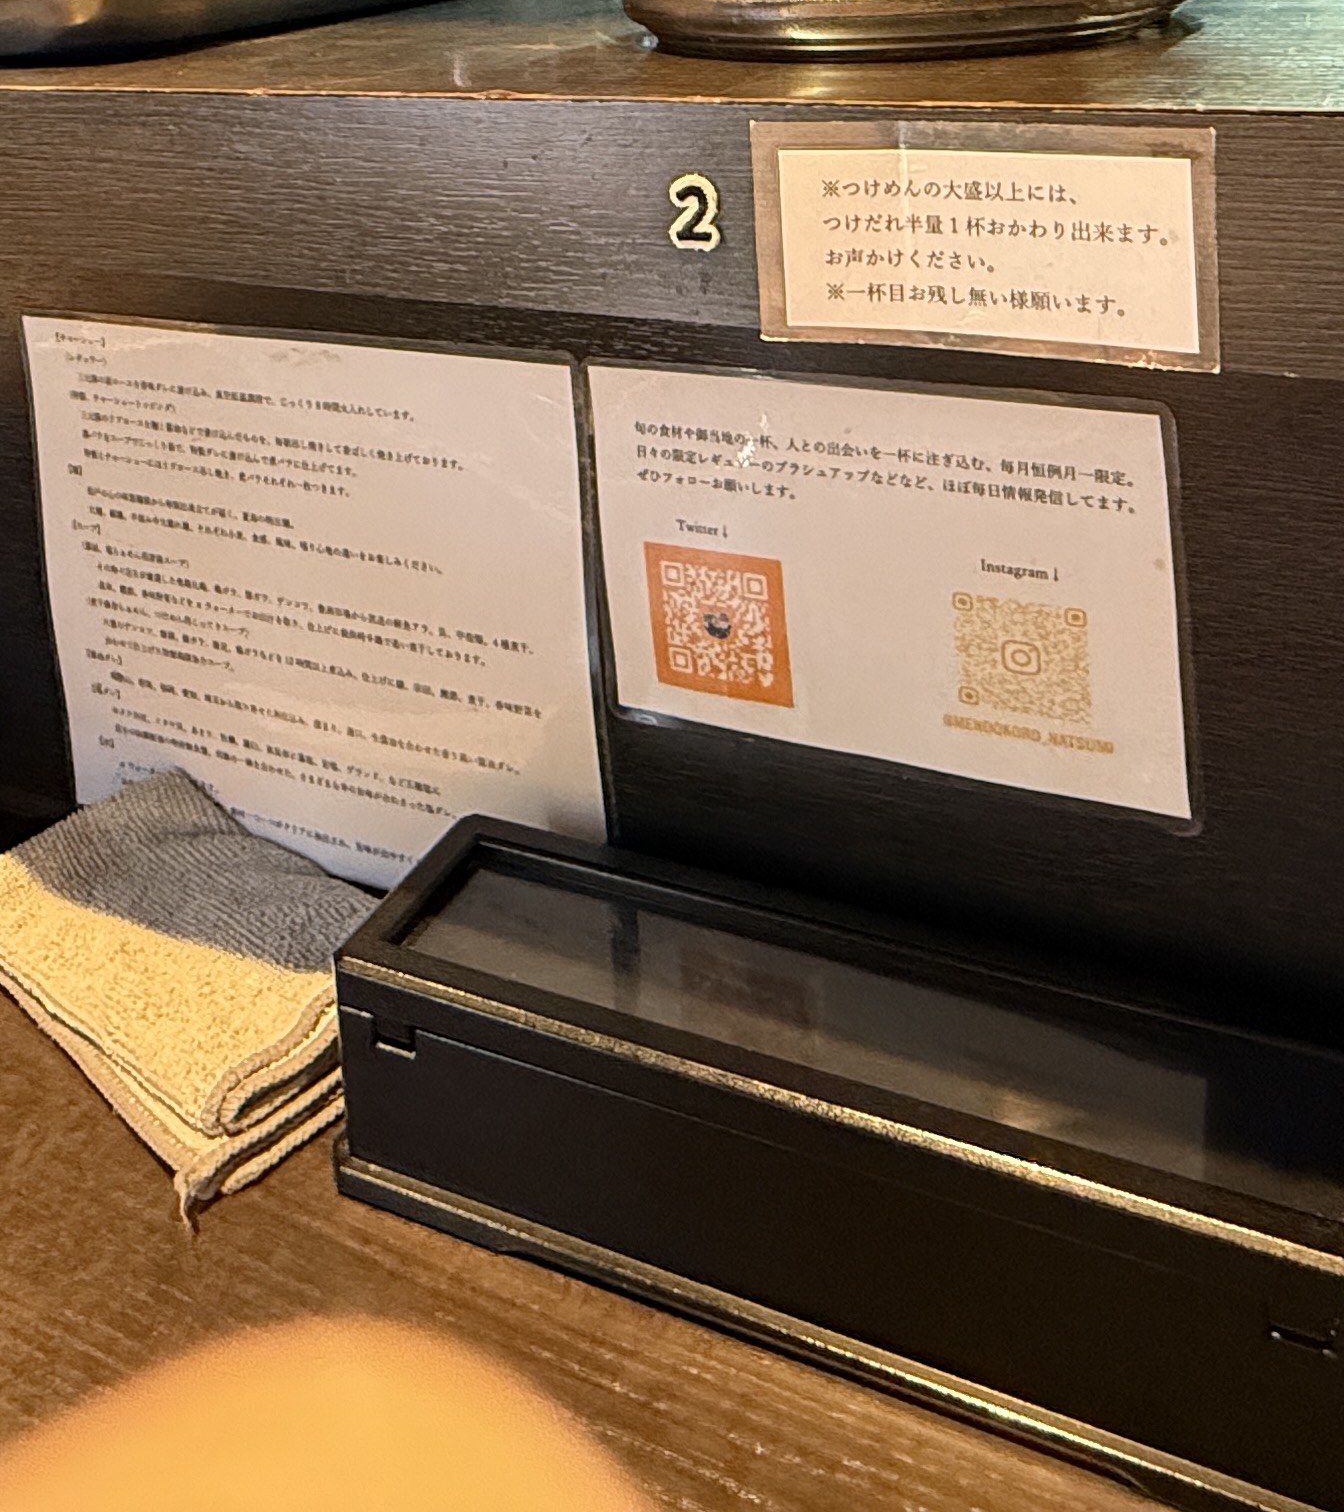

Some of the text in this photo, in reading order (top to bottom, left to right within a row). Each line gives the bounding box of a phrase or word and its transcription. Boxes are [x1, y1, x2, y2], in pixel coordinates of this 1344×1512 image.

[821, 179, 1077, 205] ※つけめんの大盛以上には、
[669, 173, 721, 252] 2
[823, 214, 1170, 247] つけだれ半量1杯おかわり出来ます。
[824, 248, 995, 273] お声かけください。
[826, 282, 1126, 317] ※一杯目お残し無い様願います。
[675, 519, 719, 537] Twitter
[980, 558, 1049, 581] Instagram
